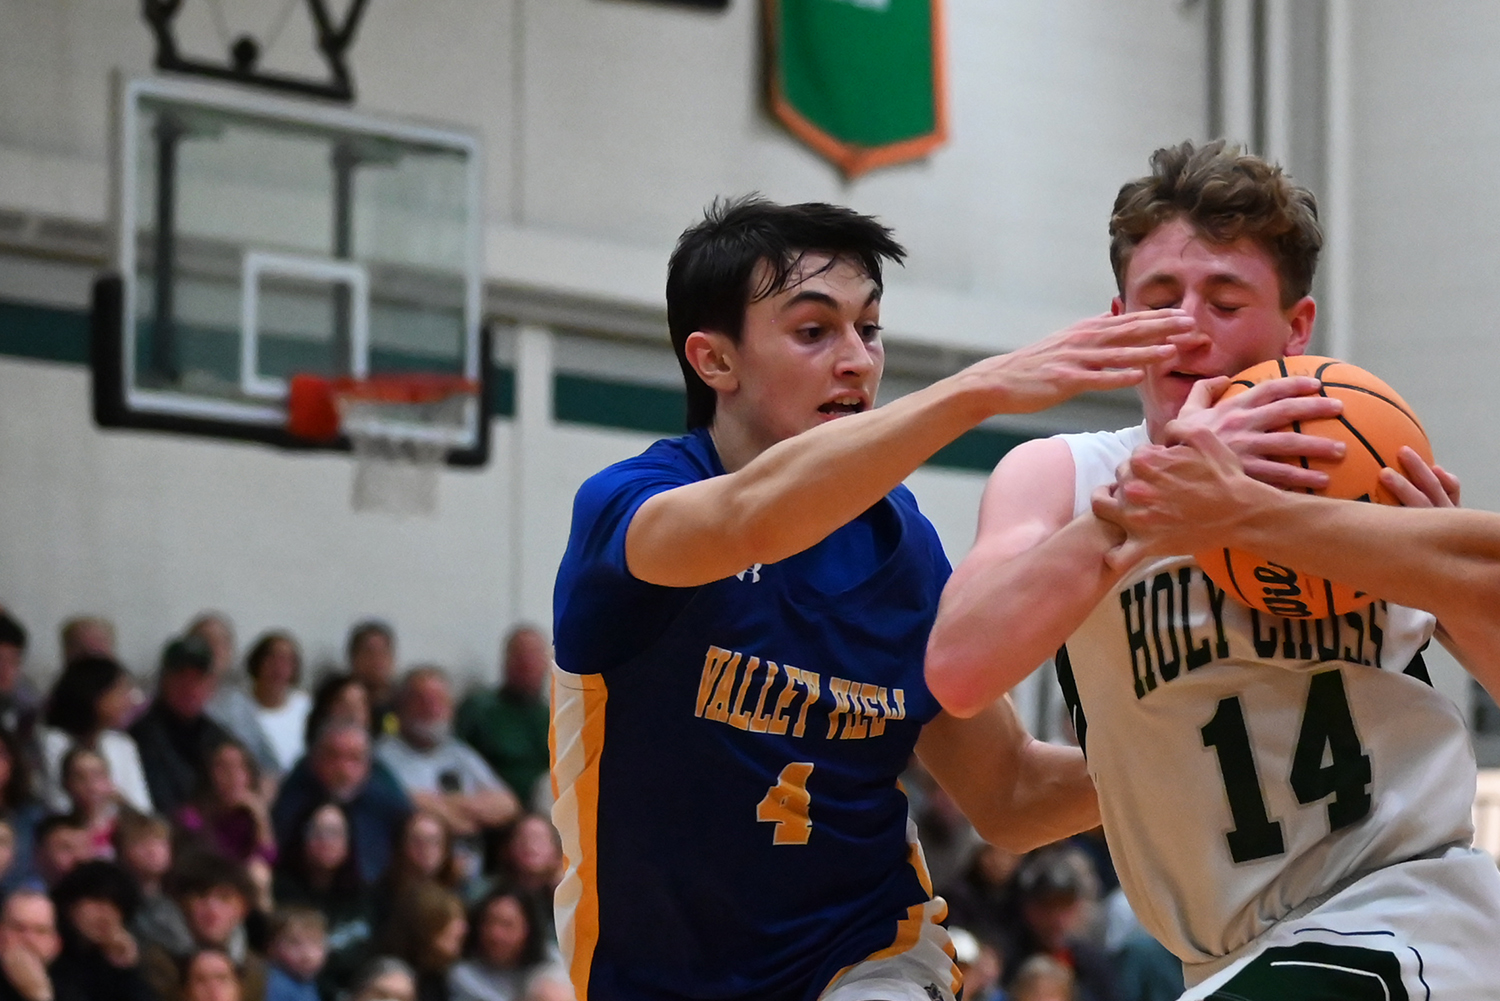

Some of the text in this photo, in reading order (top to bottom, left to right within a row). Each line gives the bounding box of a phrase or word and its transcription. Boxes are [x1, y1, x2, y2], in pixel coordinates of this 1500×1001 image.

[1120, 567, 1230, 700] HOLY
[694, 645, 820, 738] VALLEY
[756, 762, 814, 845] 4
[1201, 669, 1373, 863] 14
